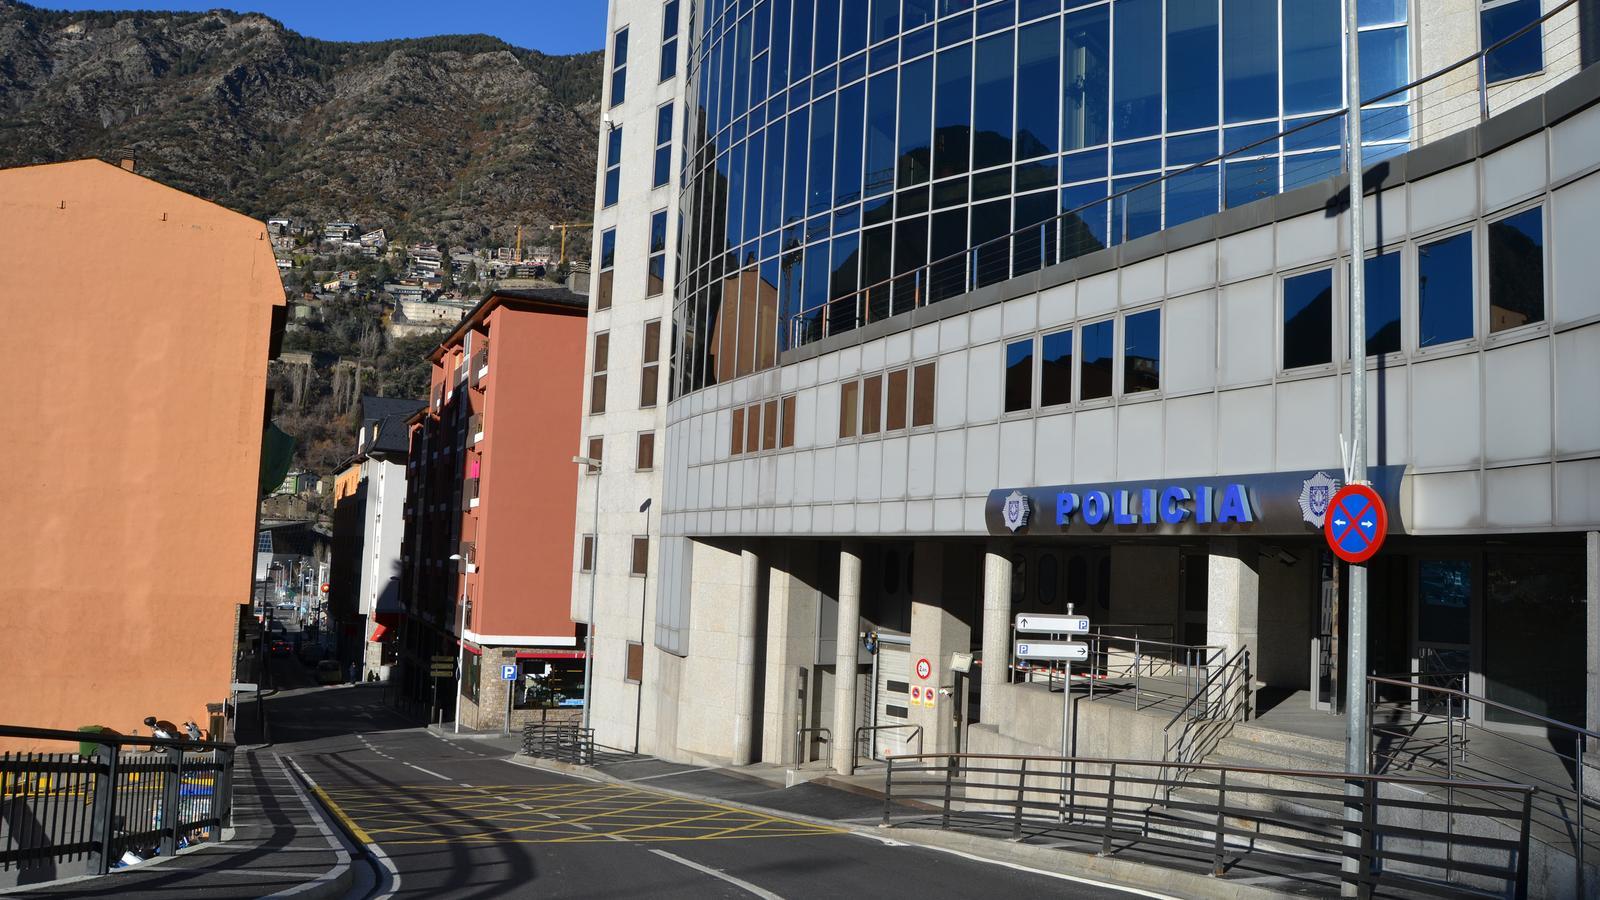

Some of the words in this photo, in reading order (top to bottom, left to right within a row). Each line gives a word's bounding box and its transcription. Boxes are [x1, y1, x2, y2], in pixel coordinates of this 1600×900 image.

[1056, 484, 1253, 525] POLICIA
[1079, 621, 1087, 629] P
[1020, 645, 1027, 653] P
[504, 666, 514, 679] P
